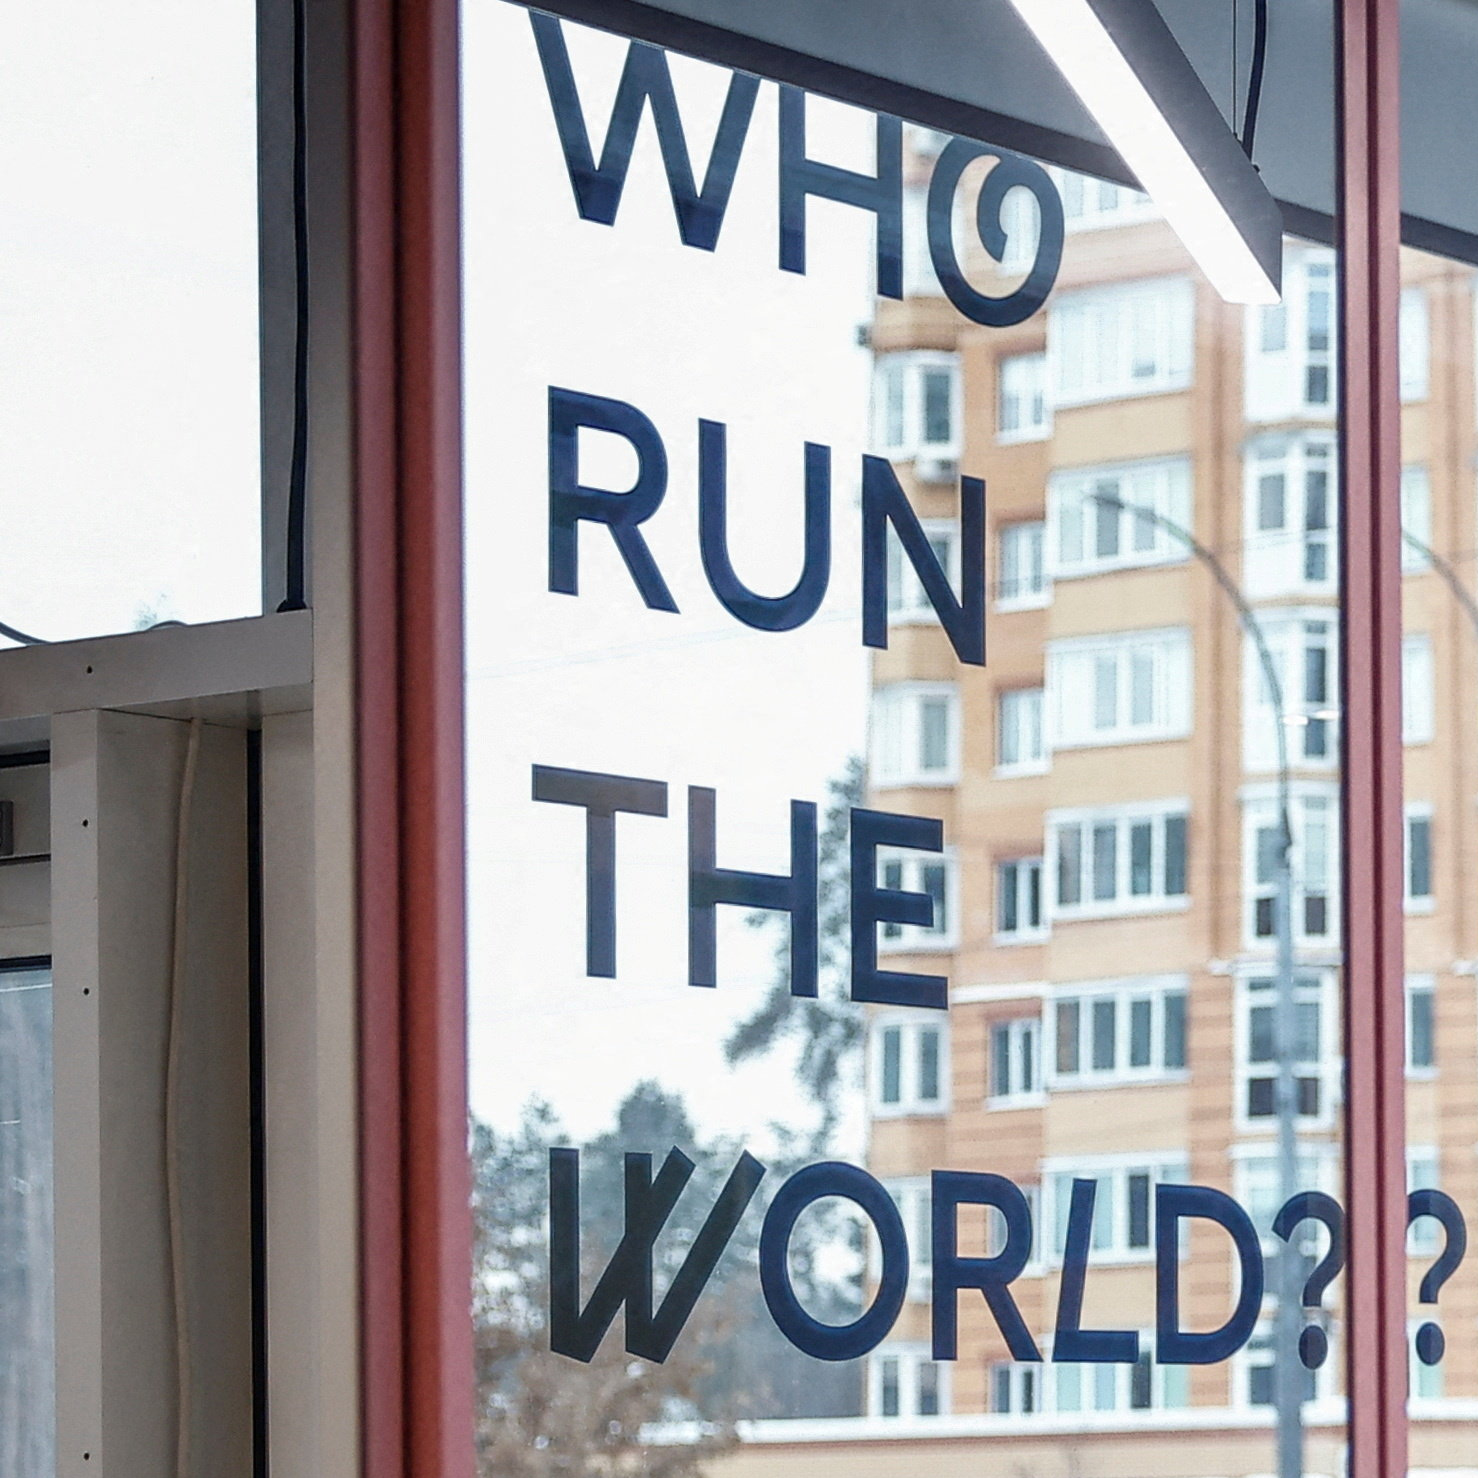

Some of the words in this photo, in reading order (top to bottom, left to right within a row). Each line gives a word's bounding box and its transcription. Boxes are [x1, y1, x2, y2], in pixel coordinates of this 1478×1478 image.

[528, 8, 1065, 328] WHO
[547, 385, 987, 668] RUN
[531, 764, 949, 1011] THE
